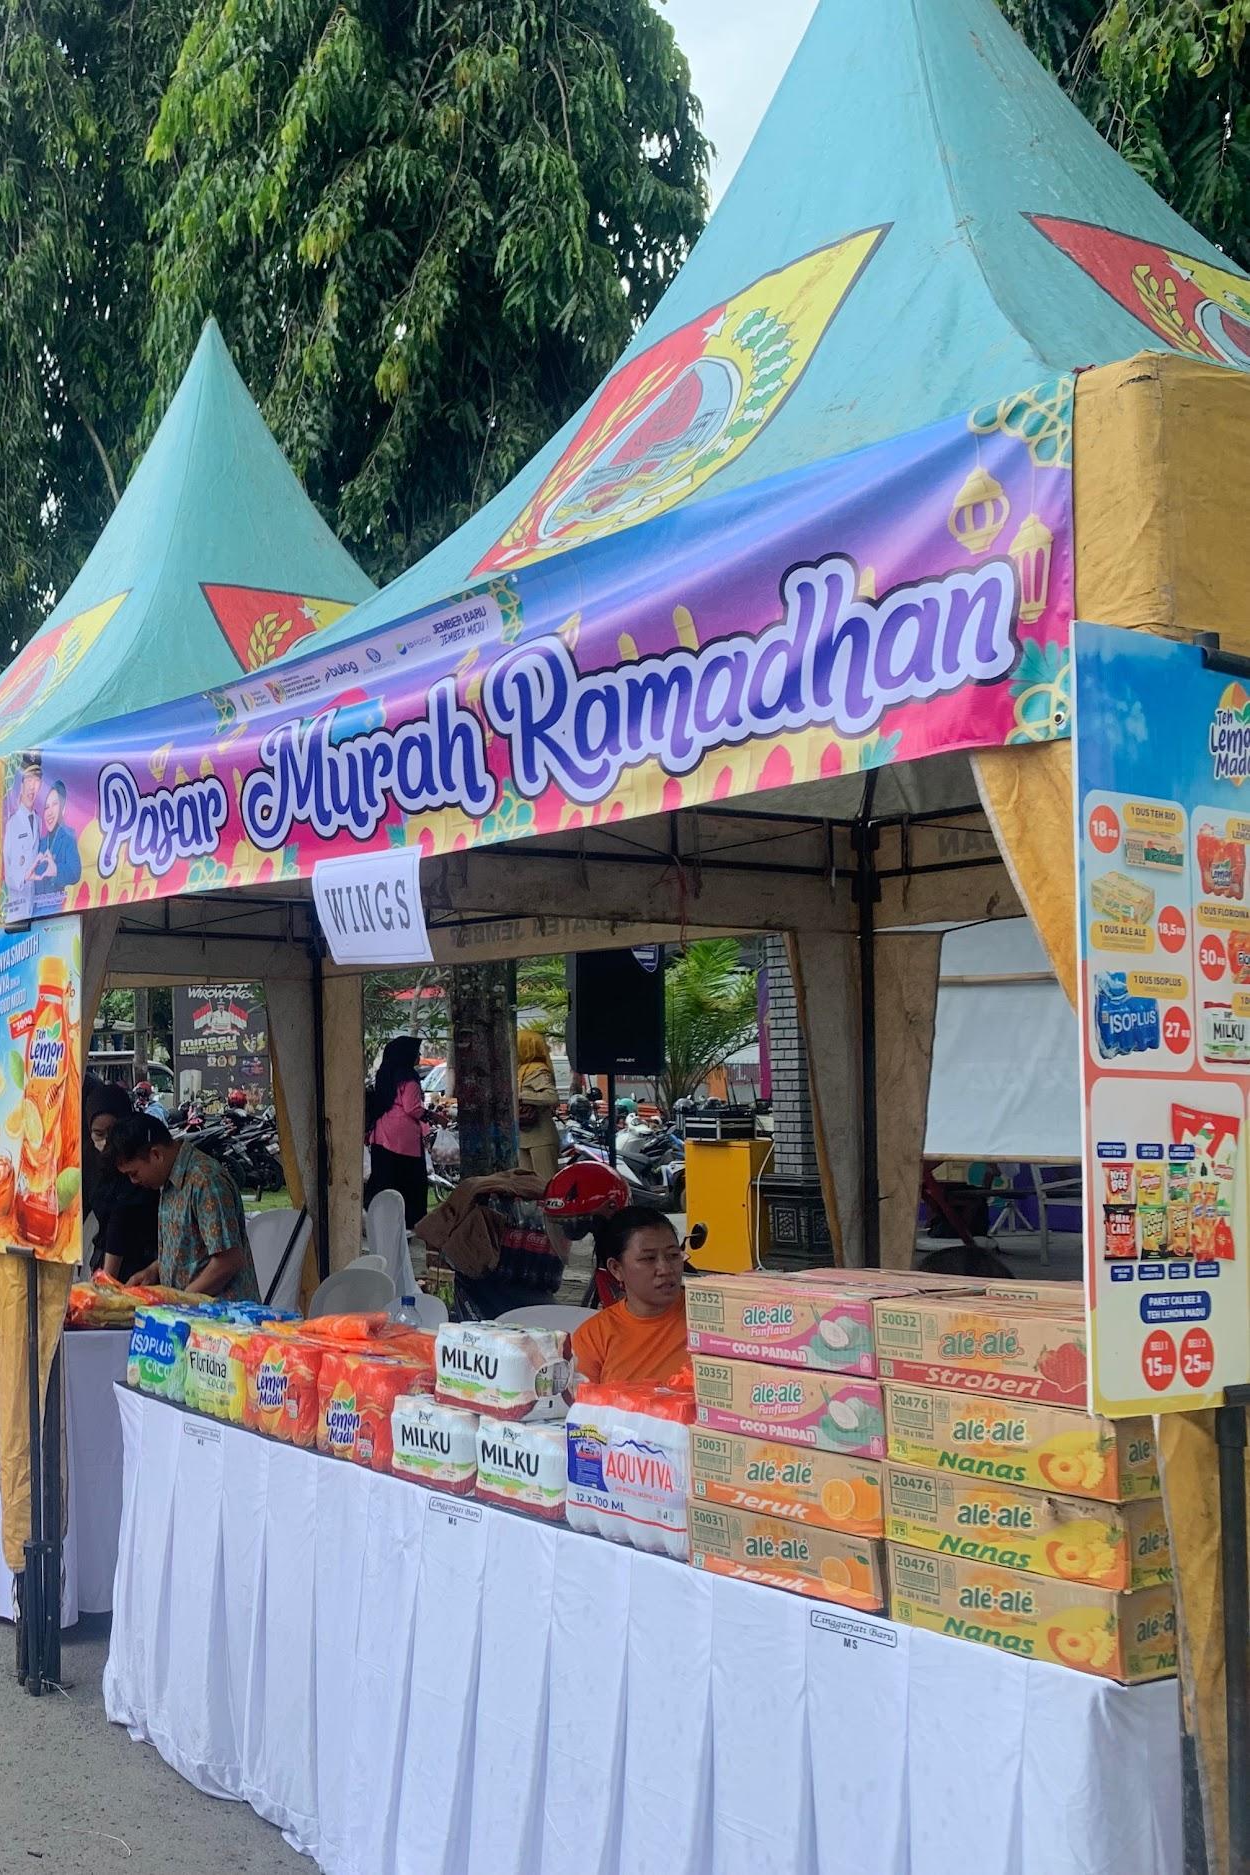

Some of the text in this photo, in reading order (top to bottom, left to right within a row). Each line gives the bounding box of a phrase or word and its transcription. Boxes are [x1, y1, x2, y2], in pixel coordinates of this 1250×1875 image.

[432, 605, 487, 635] JEMBER BARU
[328, 660, 359, 678] bulog
[101, 564, 1006, 872] Pasar Murah Ramadhan
[1216, 708, 1233, 727] Teh
[1210, 725, 1250, 757] Lemo
[1135, 808, 1150, 817] DUS
[1151, 810, 1163, 818] TEH
[1165, 812, 1176, 820] RIO
[1091, 820, 1107, 838] 18
[323, 879, 412, 936] WINGS
[1104, 926, 1119, 934] DUS
[1120, 926, 1133, 935] ALE
[1134, 928, 1147, 936] ALE
[10, 933, 40, 966] SMOOTH
[1200, 949, 1216, 965] 30
[1138, 976, 1153, 984] DUS
[1153, 977, 1182, 987] ISOPLUS
[1109, 1010, 1157, 1035] ISOPLUS
[1165, 1022, 1180, 1038] 27
[1213, 1022, 1245, 1041] MILKU
[29, 1041, 64, 1062] Lemon
[30, 1060, 58, 1077] Madu
[689, 1290, 720, 1305] 20352
[881, 1312, 917, 1328] 50032
[1161, 1308, 1184, 1319] LEMON
[130, 1332, 174, 1357] ISOPLUS
[731, 1342, 760, 1356] COCO
[145, 1360, 170, 1378] COCO
[189, 1351, 227, 1379] Floridina
[441, 1345, 499, 1380] MILKU
[698, 1365, 729, 1381] 20352
[924, 1366, 1044, 1397] Stroberi
[256, 1374, 288, 1393] Lemon
[258, 1390, 284, 1407] Madu
[893, 1391, 929, 1410] 20476
[325, 1410, 360, 1430] Lemon
[739, 1419, 767, 1434] COCO
[329, 1427, 355, 1444] Madu
[401, 1424, 451, 1455] MILKU
[696, 1437, 727, 1453] 50031
[480, 1439, 540, 1477] MILKU
[937, 1450, 1027, 1482] Nanas
[605, 1449, 674, 1493] AQUVIVA
[892, 1473, 933, 1492] 20476
[575, 1492, 585, 1502] 12
[594, 1495, 609, 1508] 700
[611, 1500, 626, 1512] ML
[730, 1490, 811, 1521] Jeruk
[693, 1512, 724, 1528] 50031
[938, 1534, 1032, 1569] Nanas
[896, 1554, 934, 1574] 20476
[728, 1563, 812, 1593] Jeruk
[843, 1637, 858, 1650] MS
[869, 1627, 894, 1642] Baru
[943, 1616, 1035, 1654] Nanas
